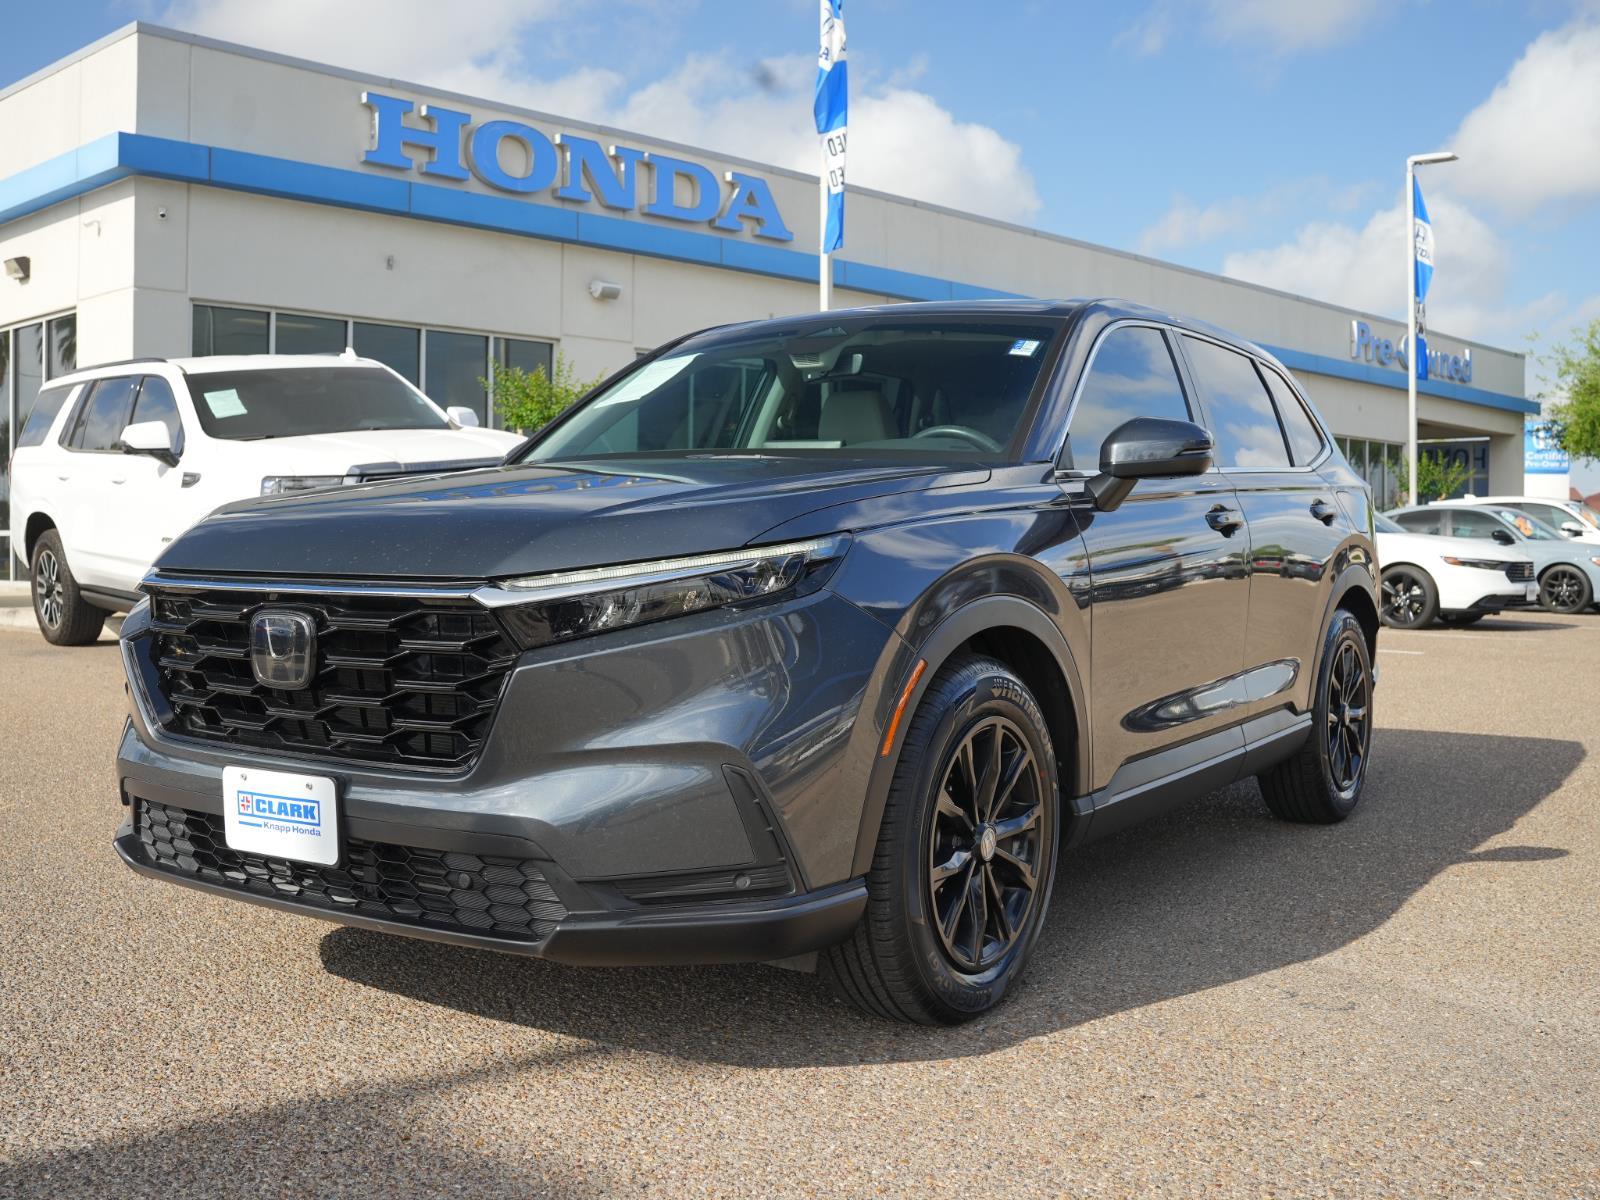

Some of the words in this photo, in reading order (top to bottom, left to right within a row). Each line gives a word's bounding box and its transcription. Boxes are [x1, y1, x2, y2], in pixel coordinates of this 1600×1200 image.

[361, 91, 794, 241] HONDA
[255, 798, 317, 820] CLARK
[263, 821, 292, 834] Knapp
[292, 825, 321, 837] Honda
